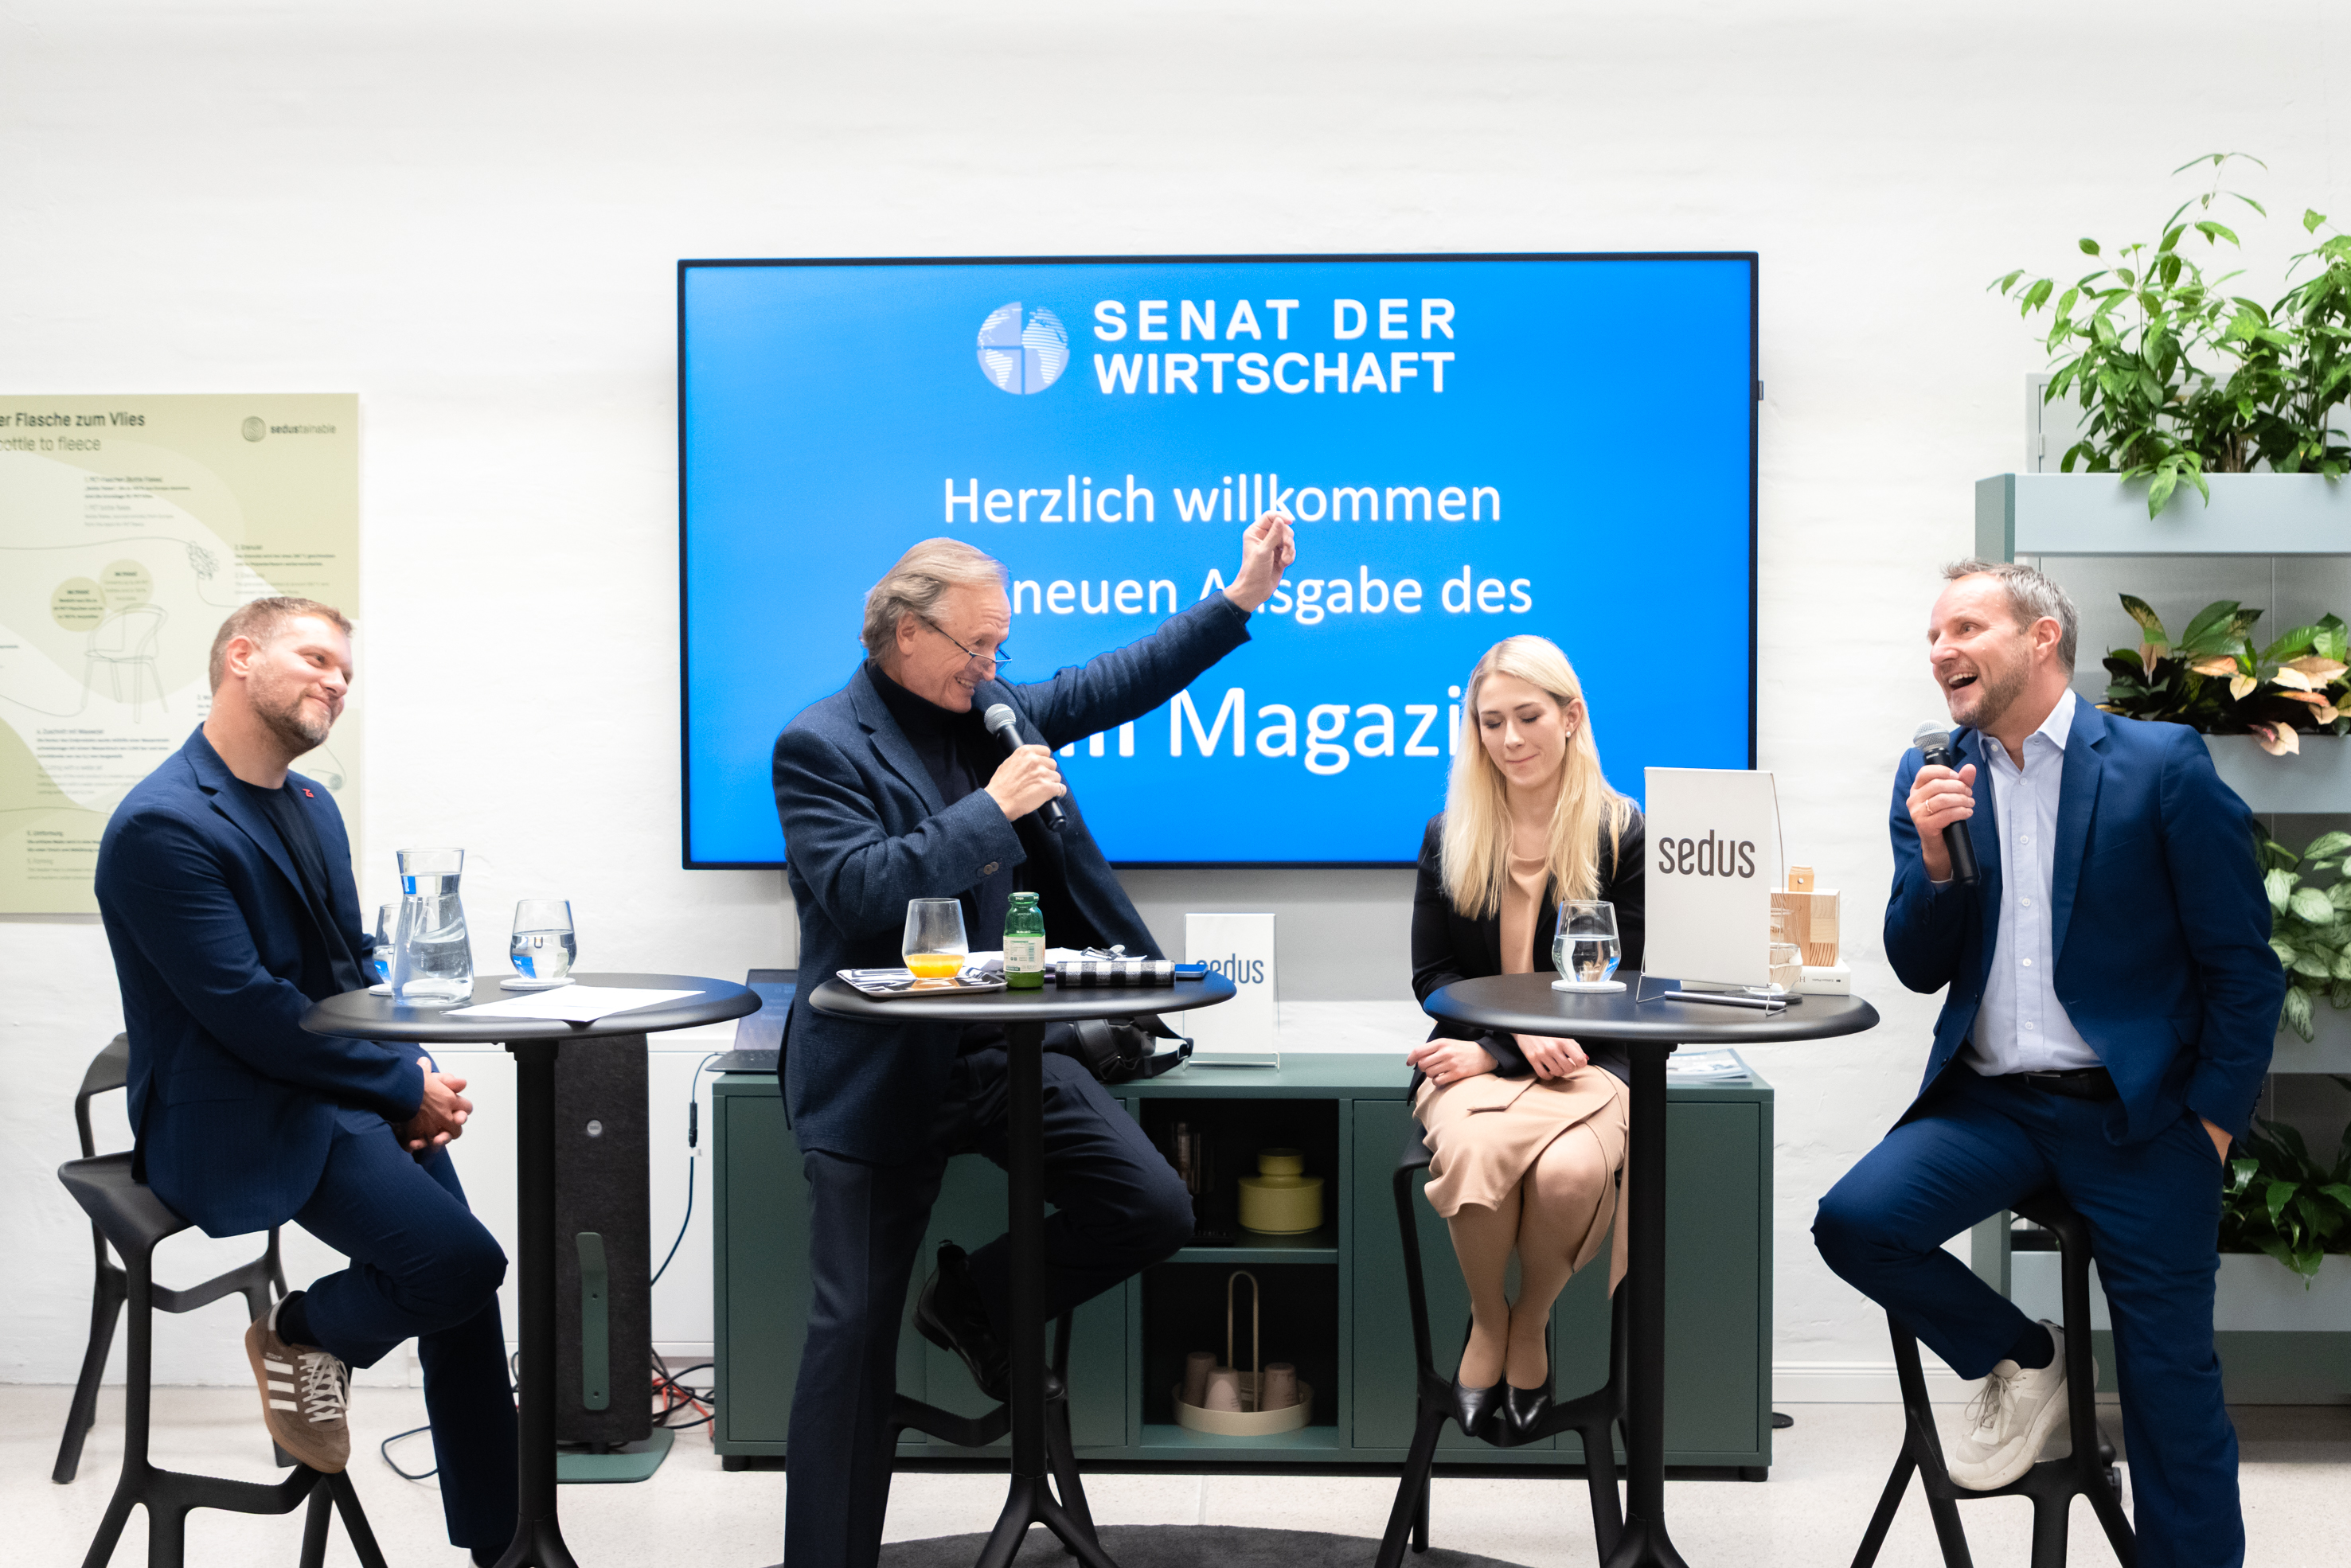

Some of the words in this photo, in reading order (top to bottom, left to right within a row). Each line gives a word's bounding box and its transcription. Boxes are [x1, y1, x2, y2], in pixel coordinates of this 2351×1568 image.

[1094, 299, 1299, 341] SENAT
[1334, 298, 1456, 340] DER
[1094, 352, 1456, 395] WIRTSCHAFT
[16, 412, 71, 427] Flasche
[76, 415, 105, 427] zum
[110, 412, 145, 427] Vlies
[41, 439, 53, 451] to
[58, 436, 100, 451] fleece
[945, 474, 1154, 524] Herzlich
[1173, 473, 1500, 522] willkommen
[1013, 579, 1177, 614] neuen
[1199, 568, 1423, 625] Asgabe
[1441, 564, 1533, 614] des
[1658, 829, 1755, 879] sedus
[1196, 953, 1264, 984] edus
